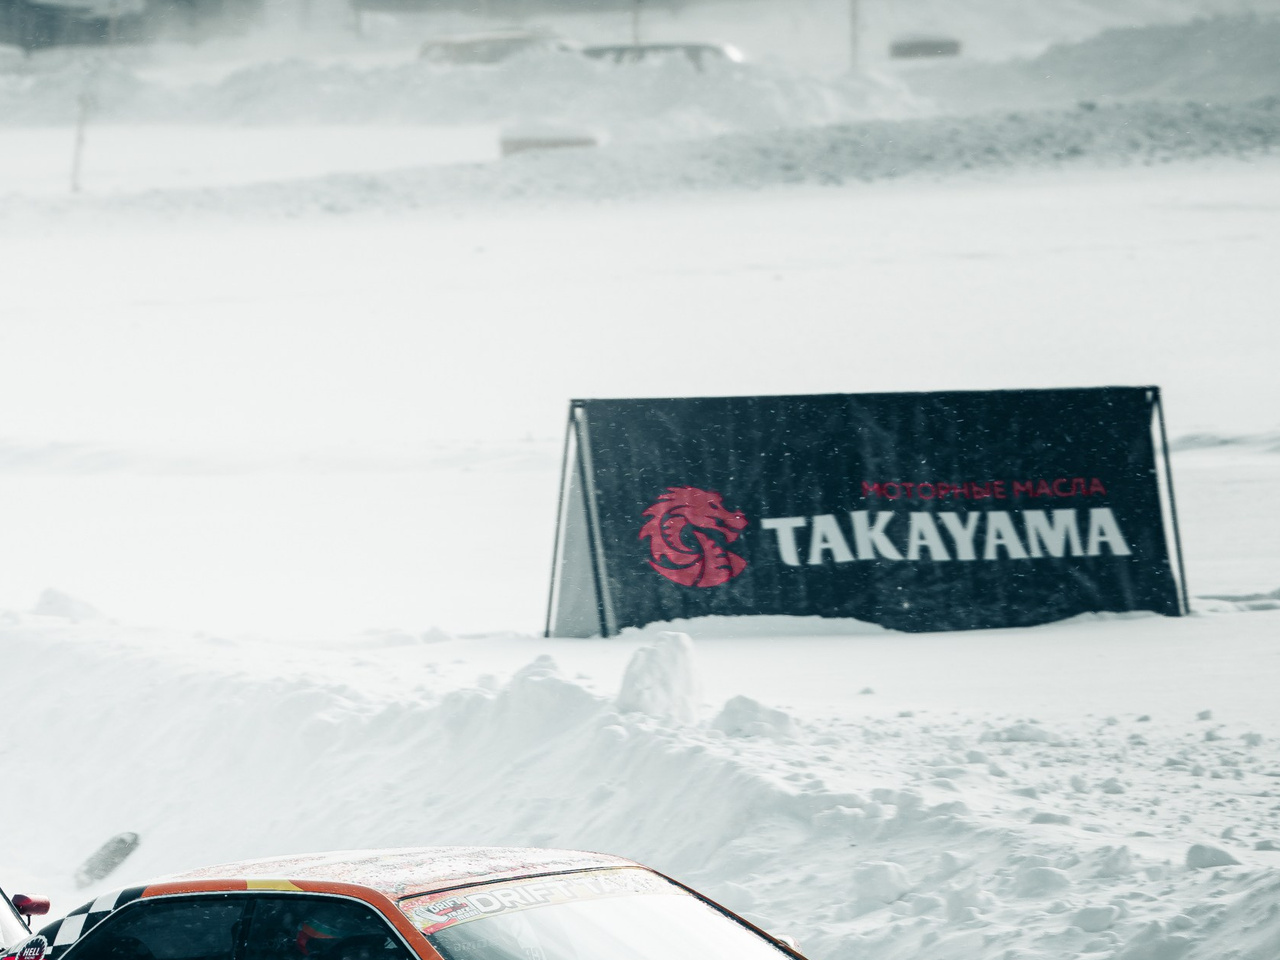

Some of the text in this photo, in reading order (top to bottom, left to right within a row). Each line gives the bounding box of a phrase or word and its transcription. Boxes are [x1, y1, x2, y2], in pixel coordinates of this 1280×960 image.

[861, 478, 1107, 500] МОТОРНЫЕ МАСЛА
[762, 507, 1132, 566] TAKAYAMA
[428, 897, 462, 913] DRIFT
[465, 881, 574, 914] DRIFT
[22, 947, 40, 957] HELL
